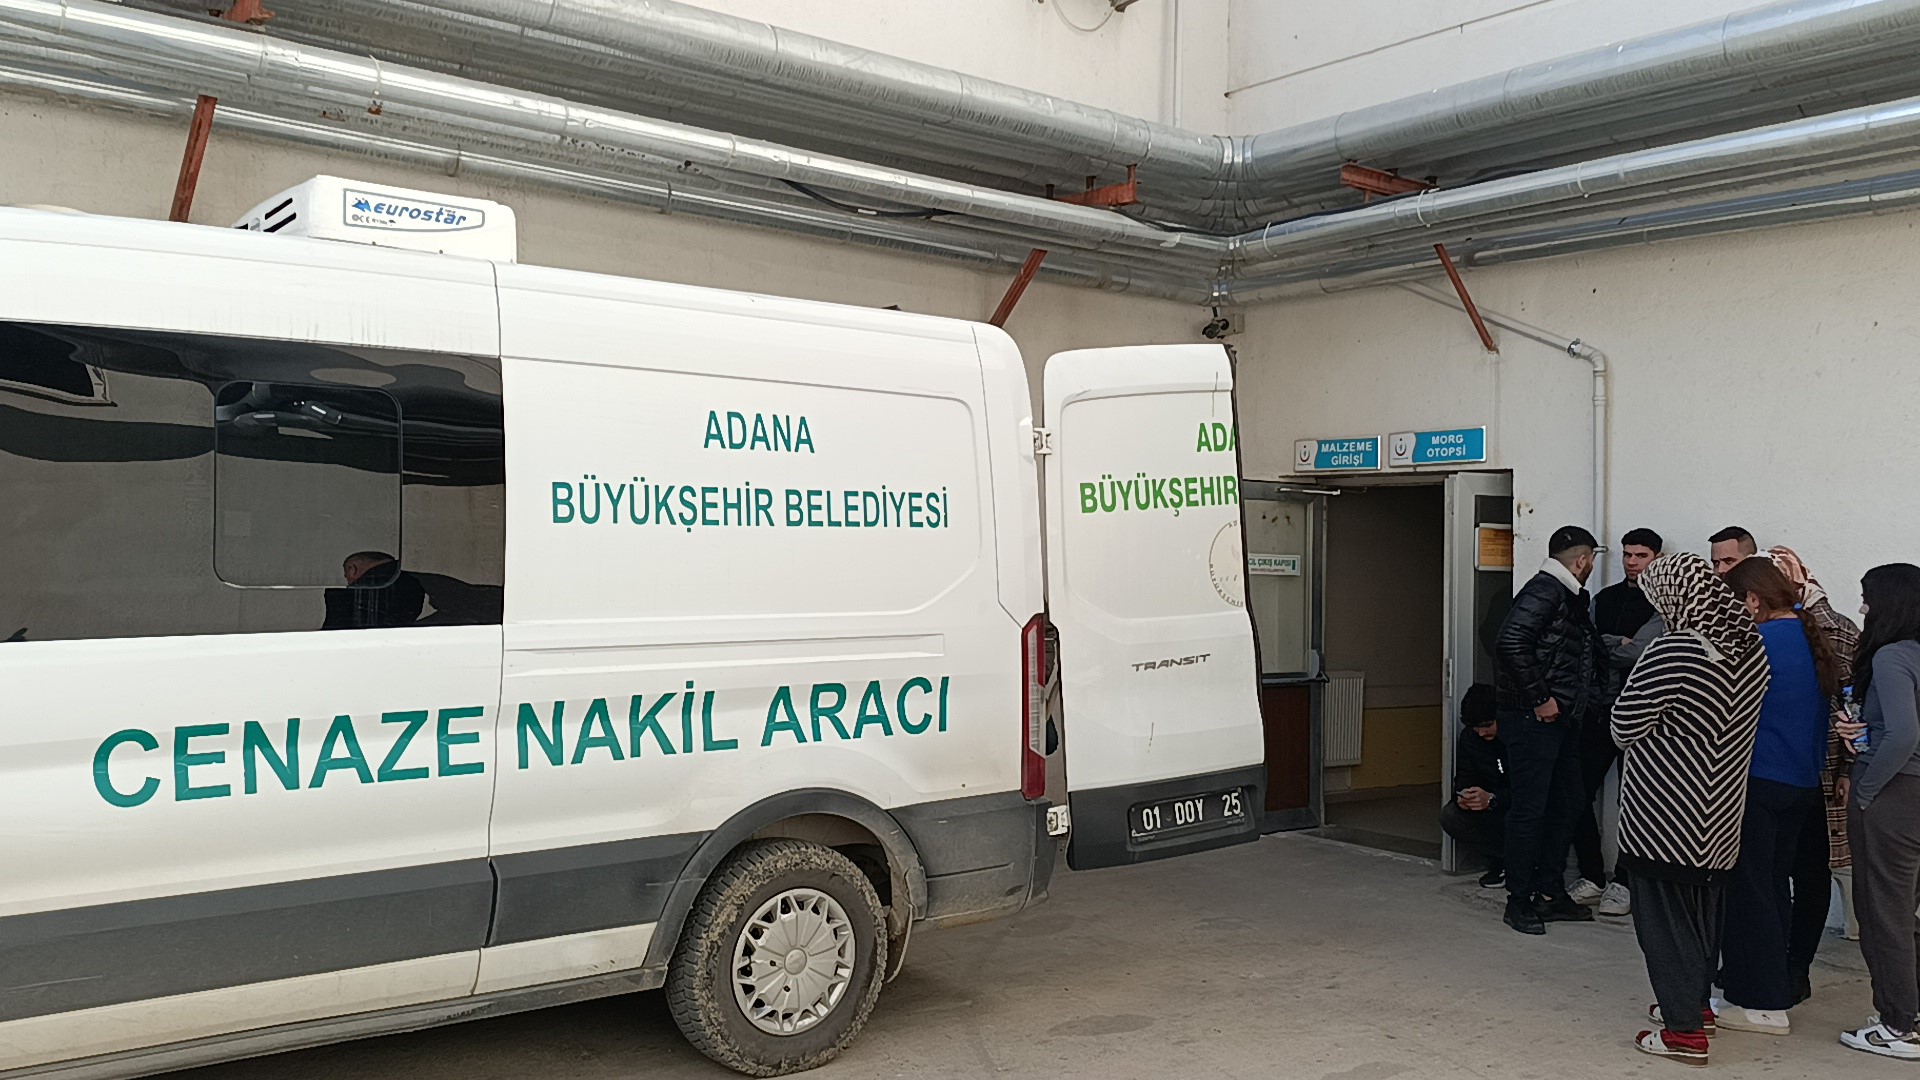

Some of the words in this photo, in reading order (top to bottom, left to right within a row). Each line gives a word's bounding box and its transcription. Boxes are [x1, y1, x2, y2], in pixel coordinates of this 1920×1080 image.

[704, 410, 815, 453] ADANA
[1431, 434, 1466, 445] MORG
[1321, 441, 1373, 453] MALZEME
[1426, 444, 1466, 458] OTOPSİ
[1331, 453, 1364, 467] GİRİŞİ
[552, 474, 775, 533] BÜYÜKŞEHİR
[786, 485, 949, 529] BELEDİYESİ
[1132, 653, 1211, 672] TRANSIT
[92, 706, 485, 809] CENAZE
[517, 680, 739, 770] NAKİL
[760, 676, 950, 747] ARACI
[1142, 805, 1161, 830] 01
[1174, 798, 1204, 825] DOY
[1221, 792, 1241, 817] 25
